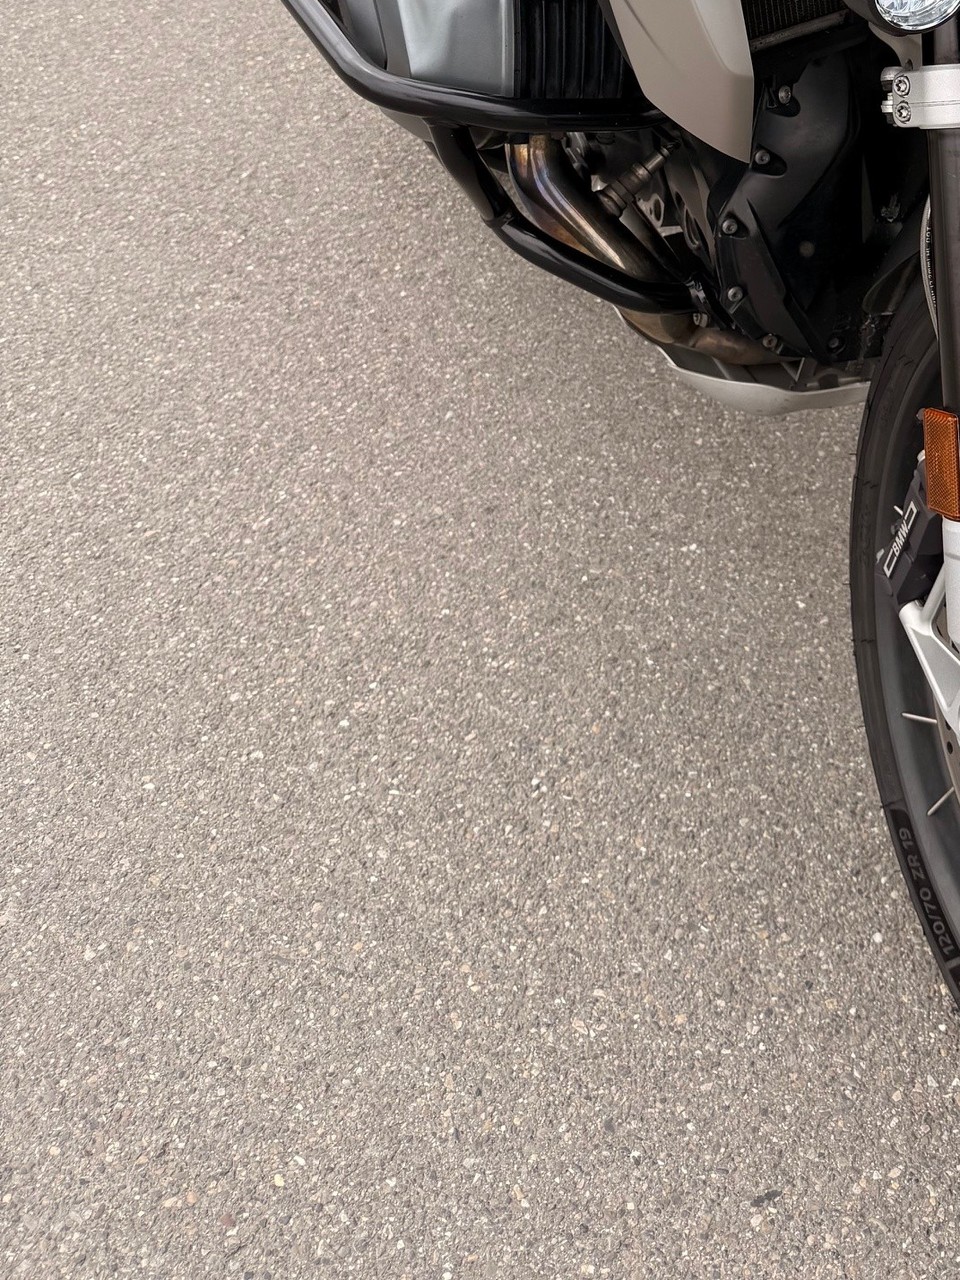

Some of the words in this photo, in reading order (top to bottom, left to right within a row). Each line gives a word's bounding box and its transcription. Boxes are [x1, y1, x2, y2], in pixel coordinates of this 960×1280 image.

[892, 519, 909, 557] BMW
[899, 827, 914, 849] 19
[906, 853, 926, 880] ZR
[919, 886, 955, 955] 120/70
